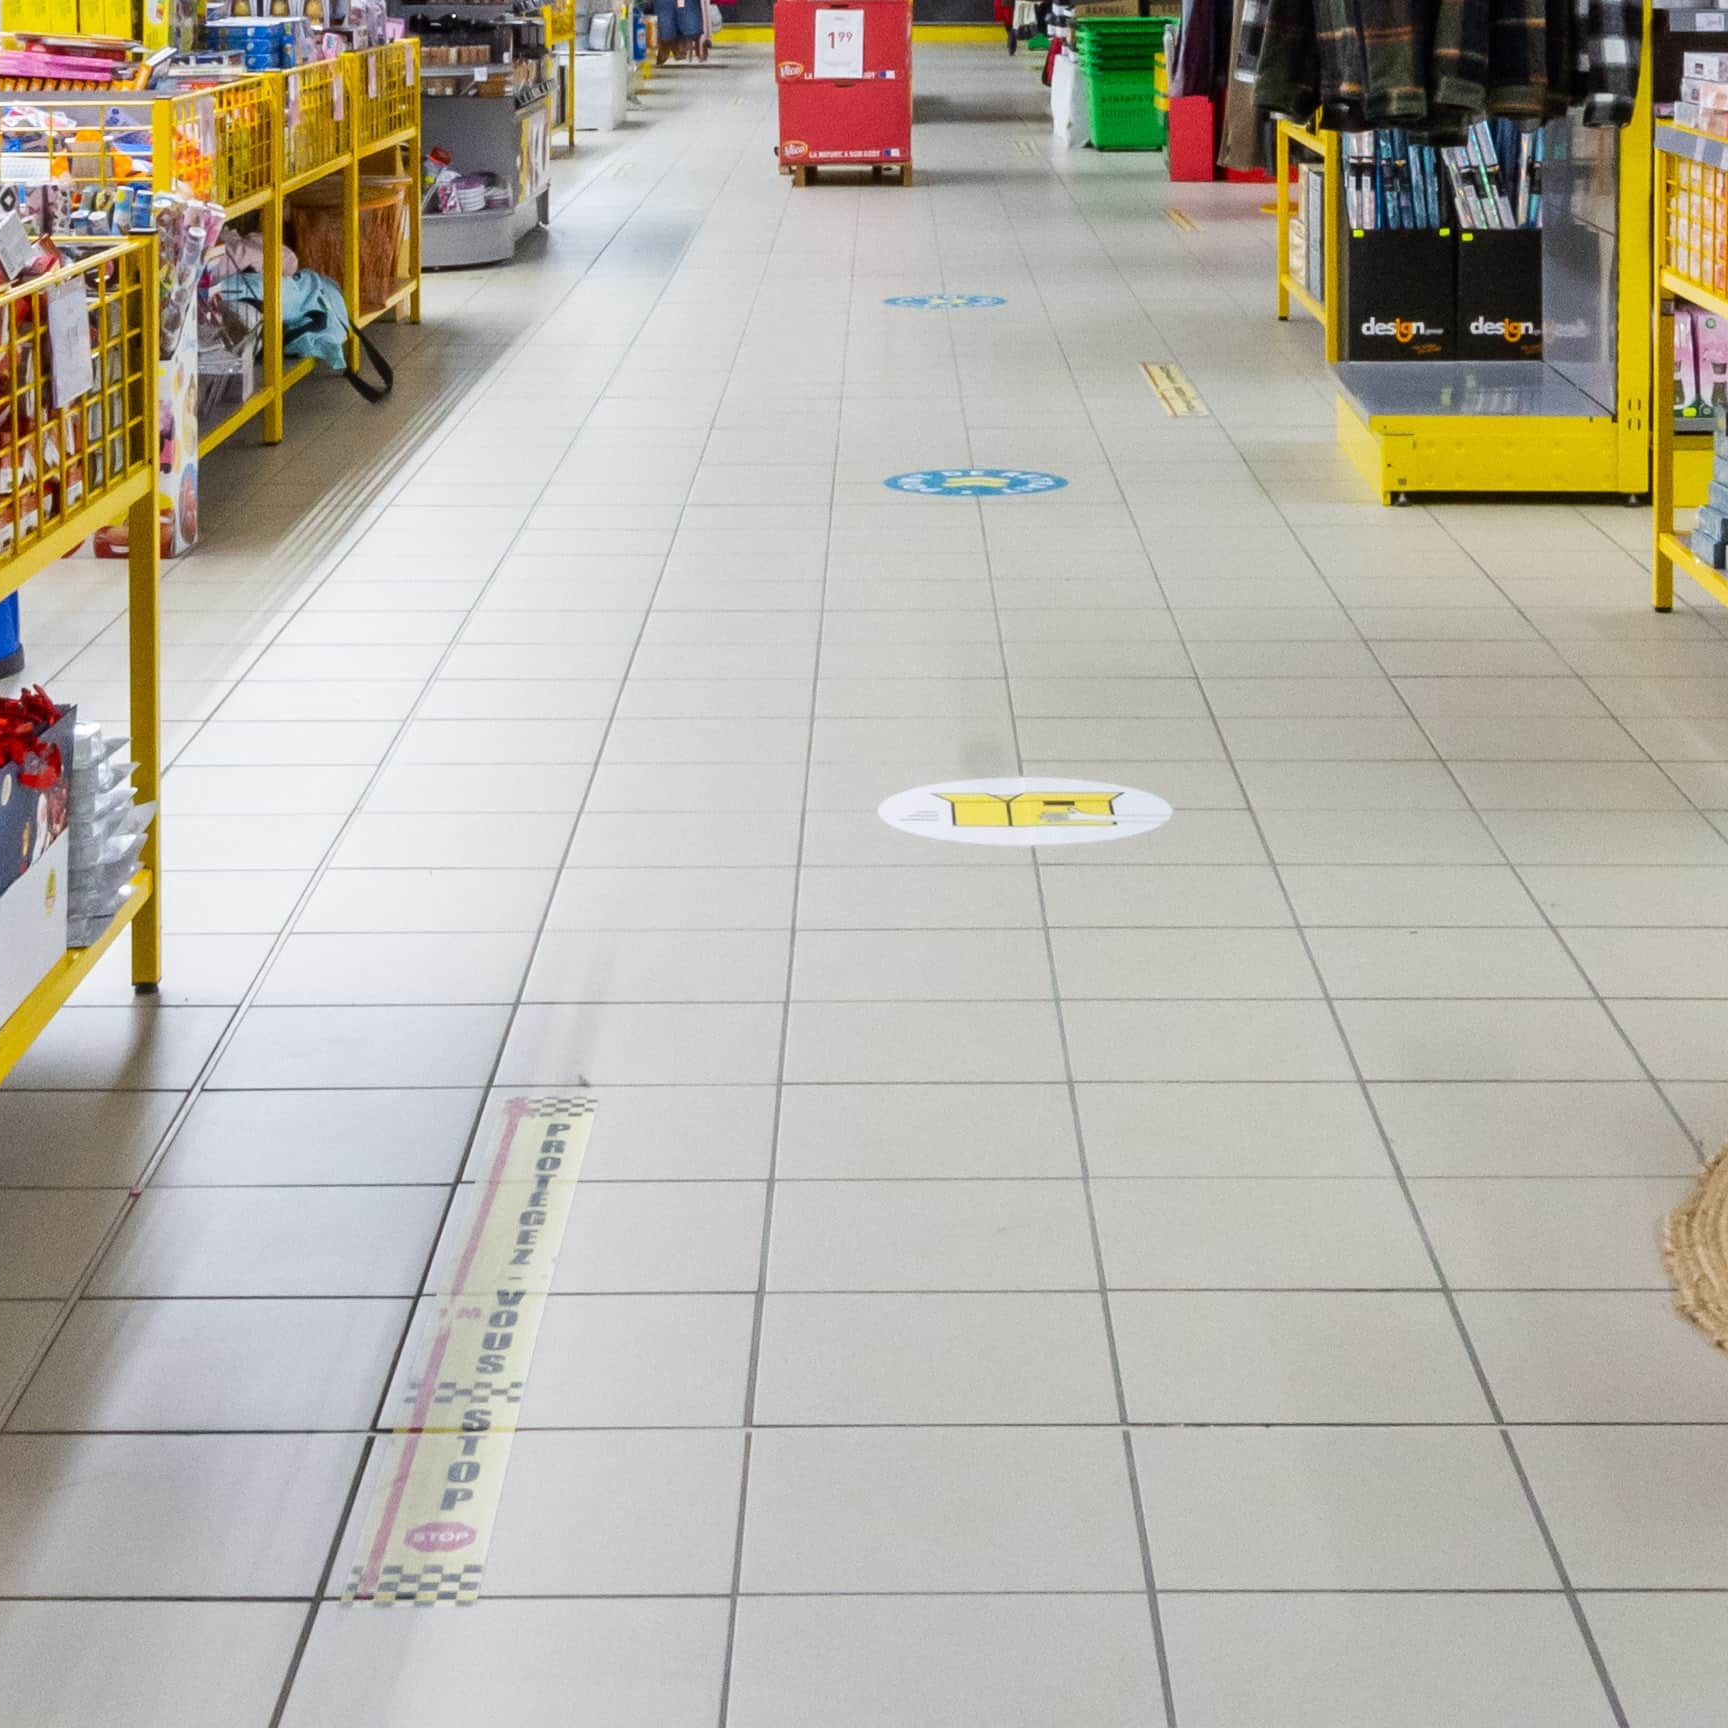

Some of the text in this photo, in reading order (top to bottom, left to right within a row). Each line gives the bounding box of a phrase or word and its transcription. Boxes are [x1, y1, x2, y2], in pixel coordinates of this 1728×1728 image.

[1361, 317, 1424, 343] design
[1470, 316, 1533, 342] design
[440, 1409, 492, 1511] STOP
[411, 1530, 469, 1543] STOP
